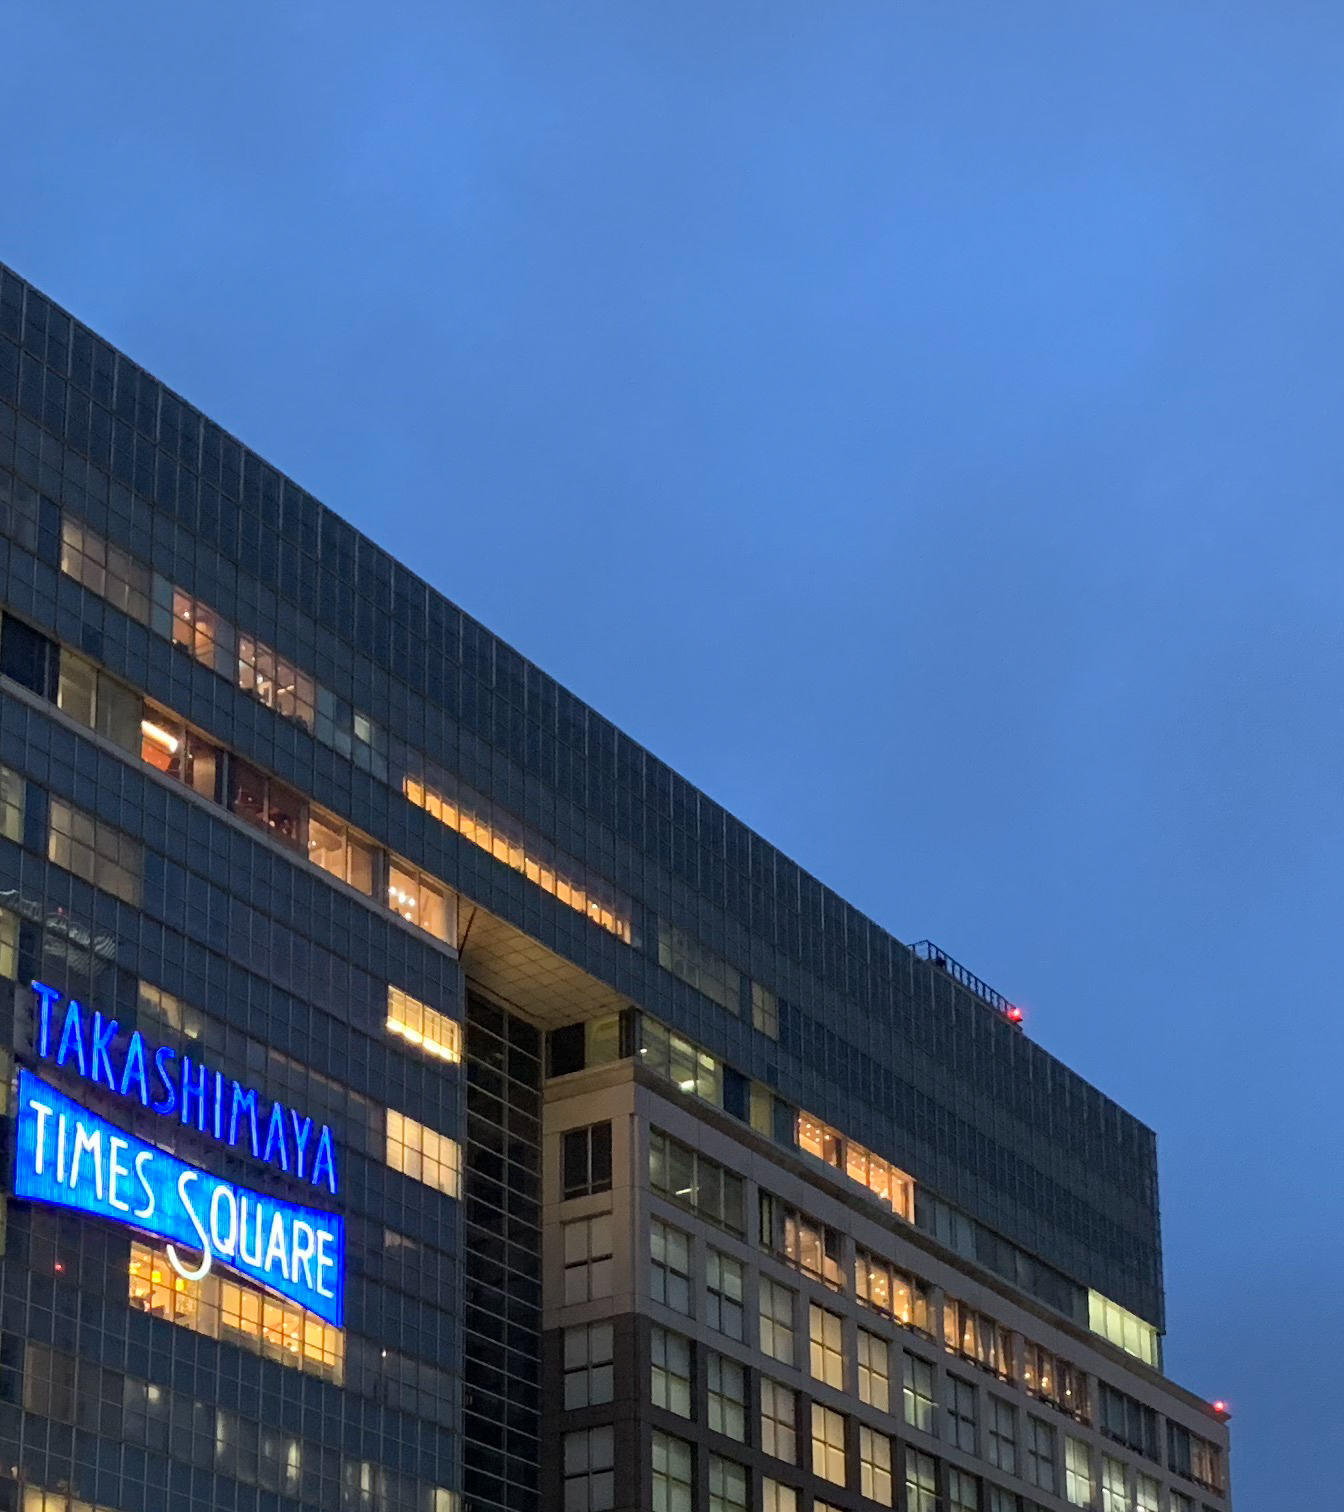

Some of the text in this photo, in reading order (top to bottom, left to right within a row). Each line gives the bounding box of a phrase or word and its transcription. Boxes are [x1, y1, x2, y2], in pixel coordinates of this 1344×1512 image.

[31, 979, 338, 1194] TAKASHIMAYA
[29, 1099, 335, 1299] TIMES SQUARE
